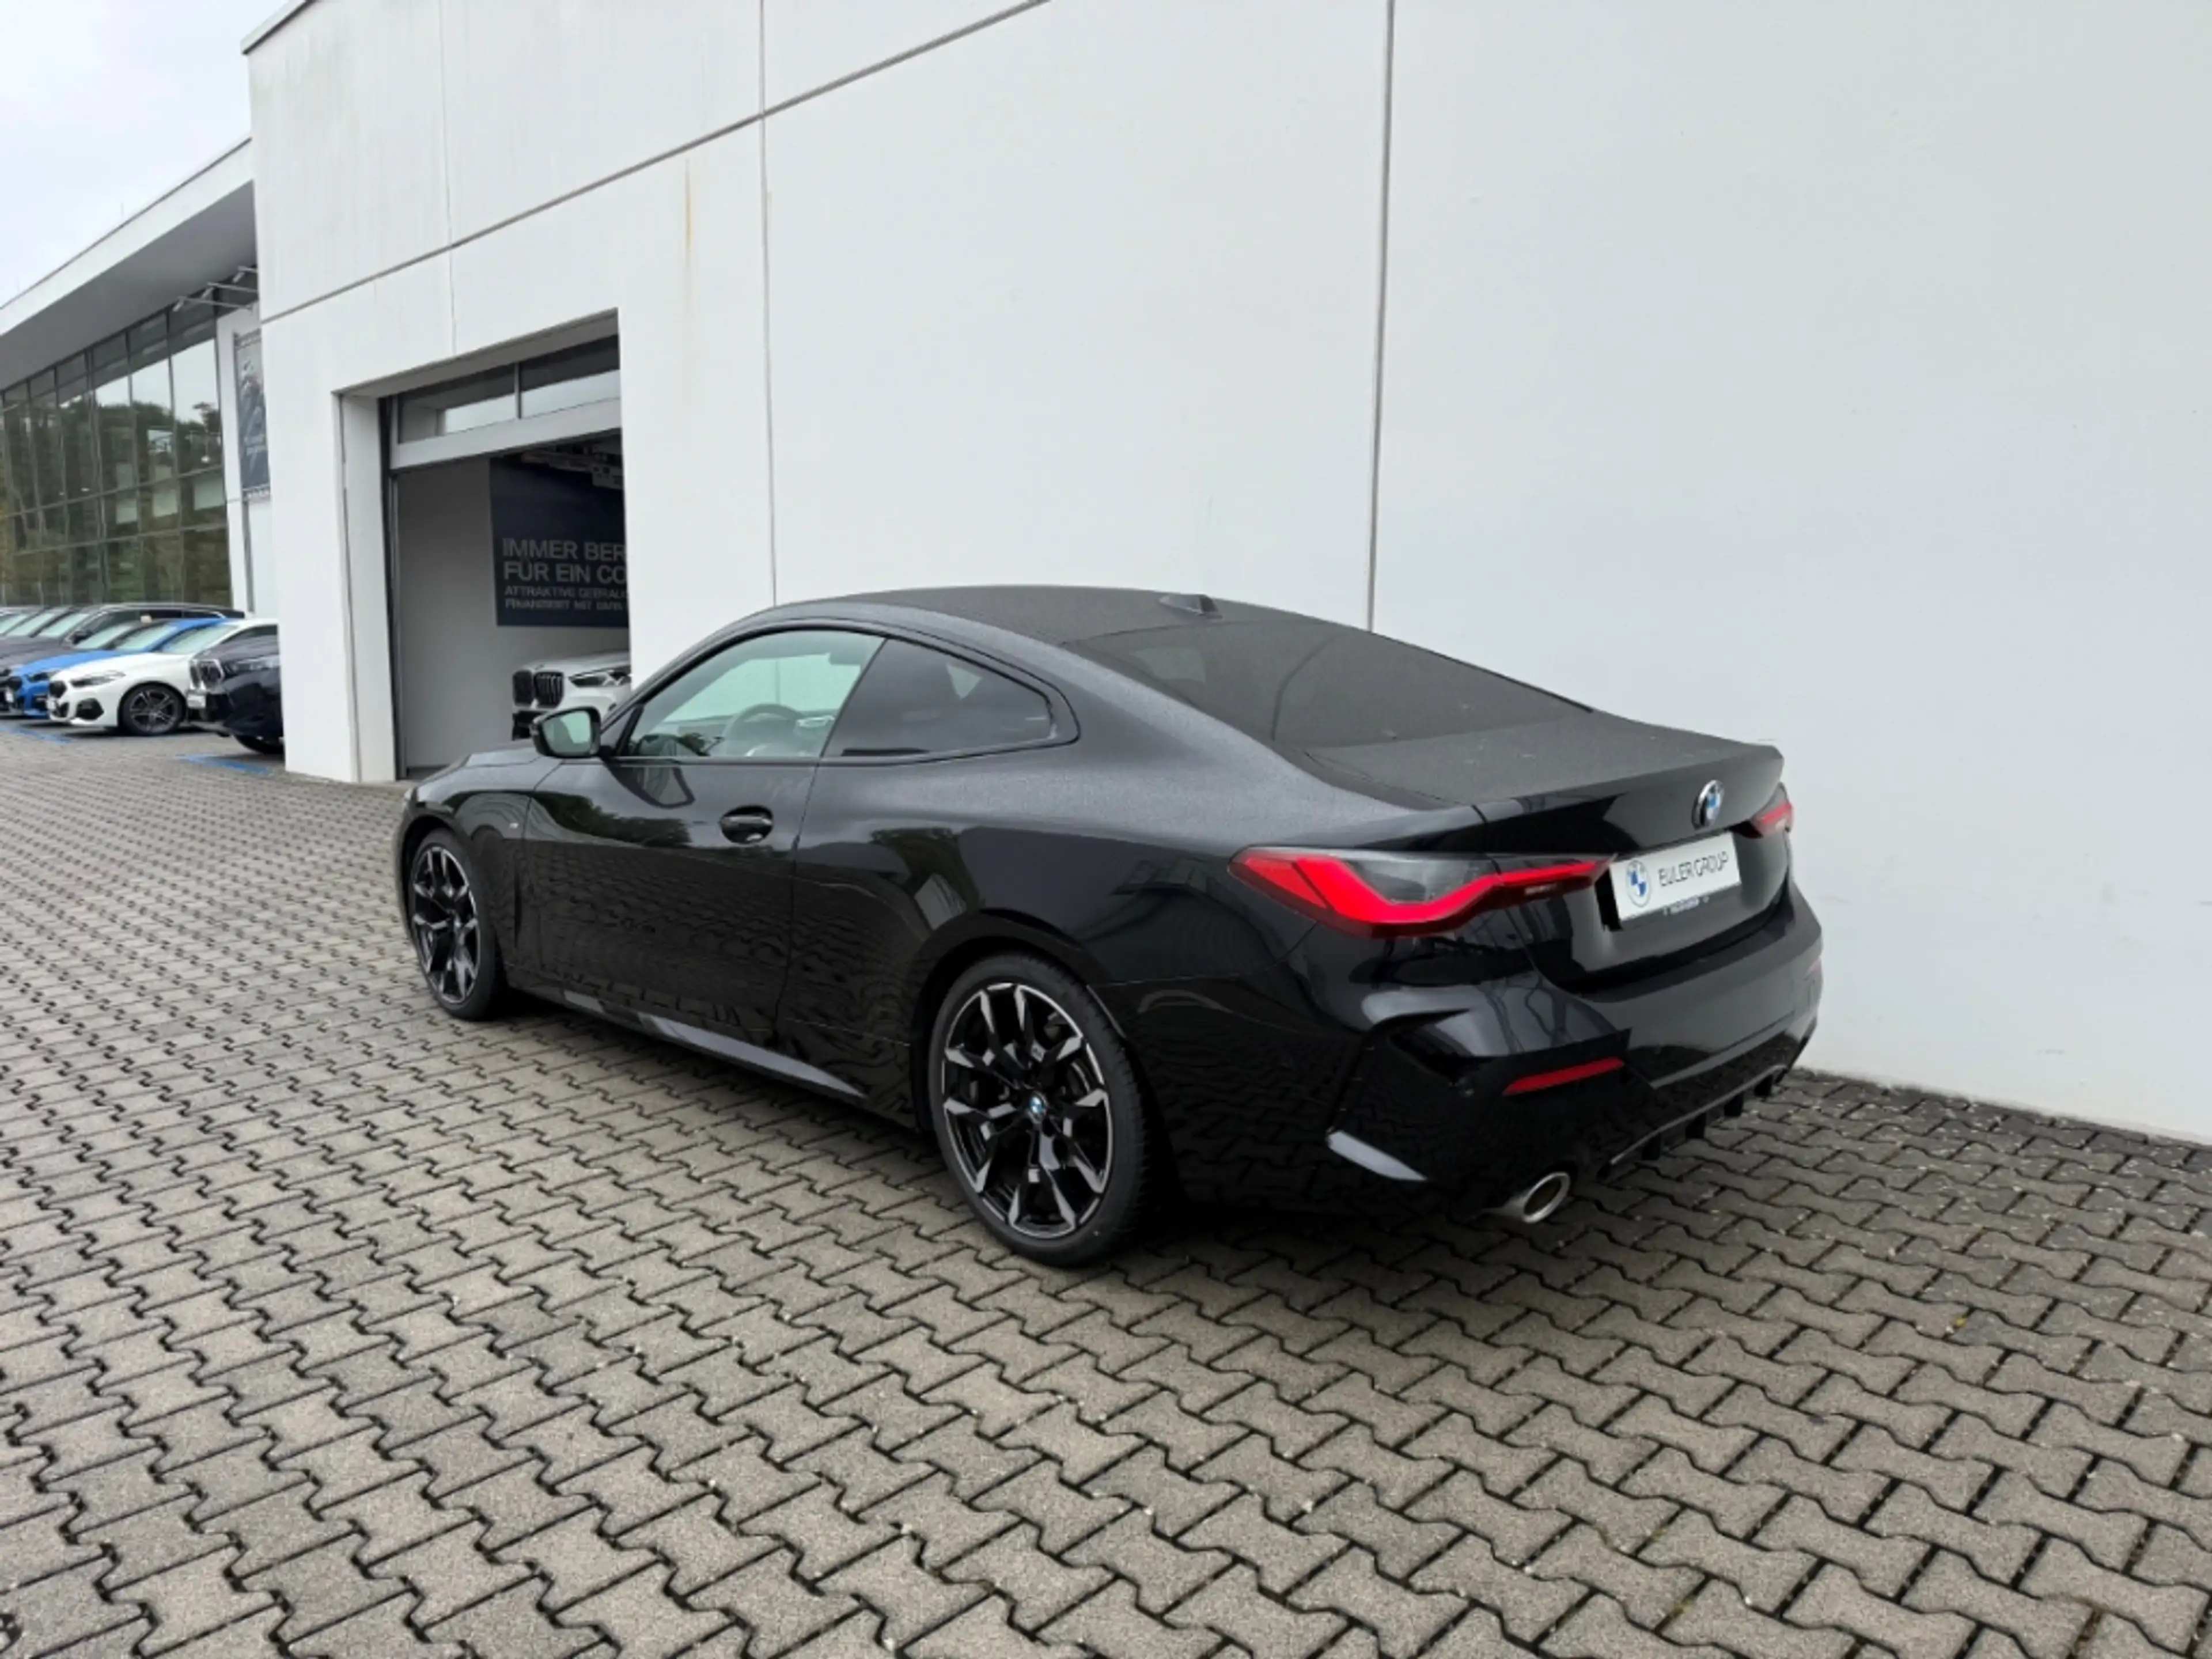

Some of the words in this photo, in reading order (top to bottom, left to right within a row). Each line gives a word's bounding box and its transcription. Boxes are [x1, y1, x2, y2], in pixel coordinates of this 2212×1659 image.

[503, 538, 578, 559] IMMER
[584, 542, 626, 561] BER
[504, 558, 550, 581] FÜR
[555, 563, 591, 584] EIN
[505, 585, 575, 598] ATTRAKTIVE
[1658, 862, 1695, 887] EULER
[1695, 851, 1729, 877] GROUP
